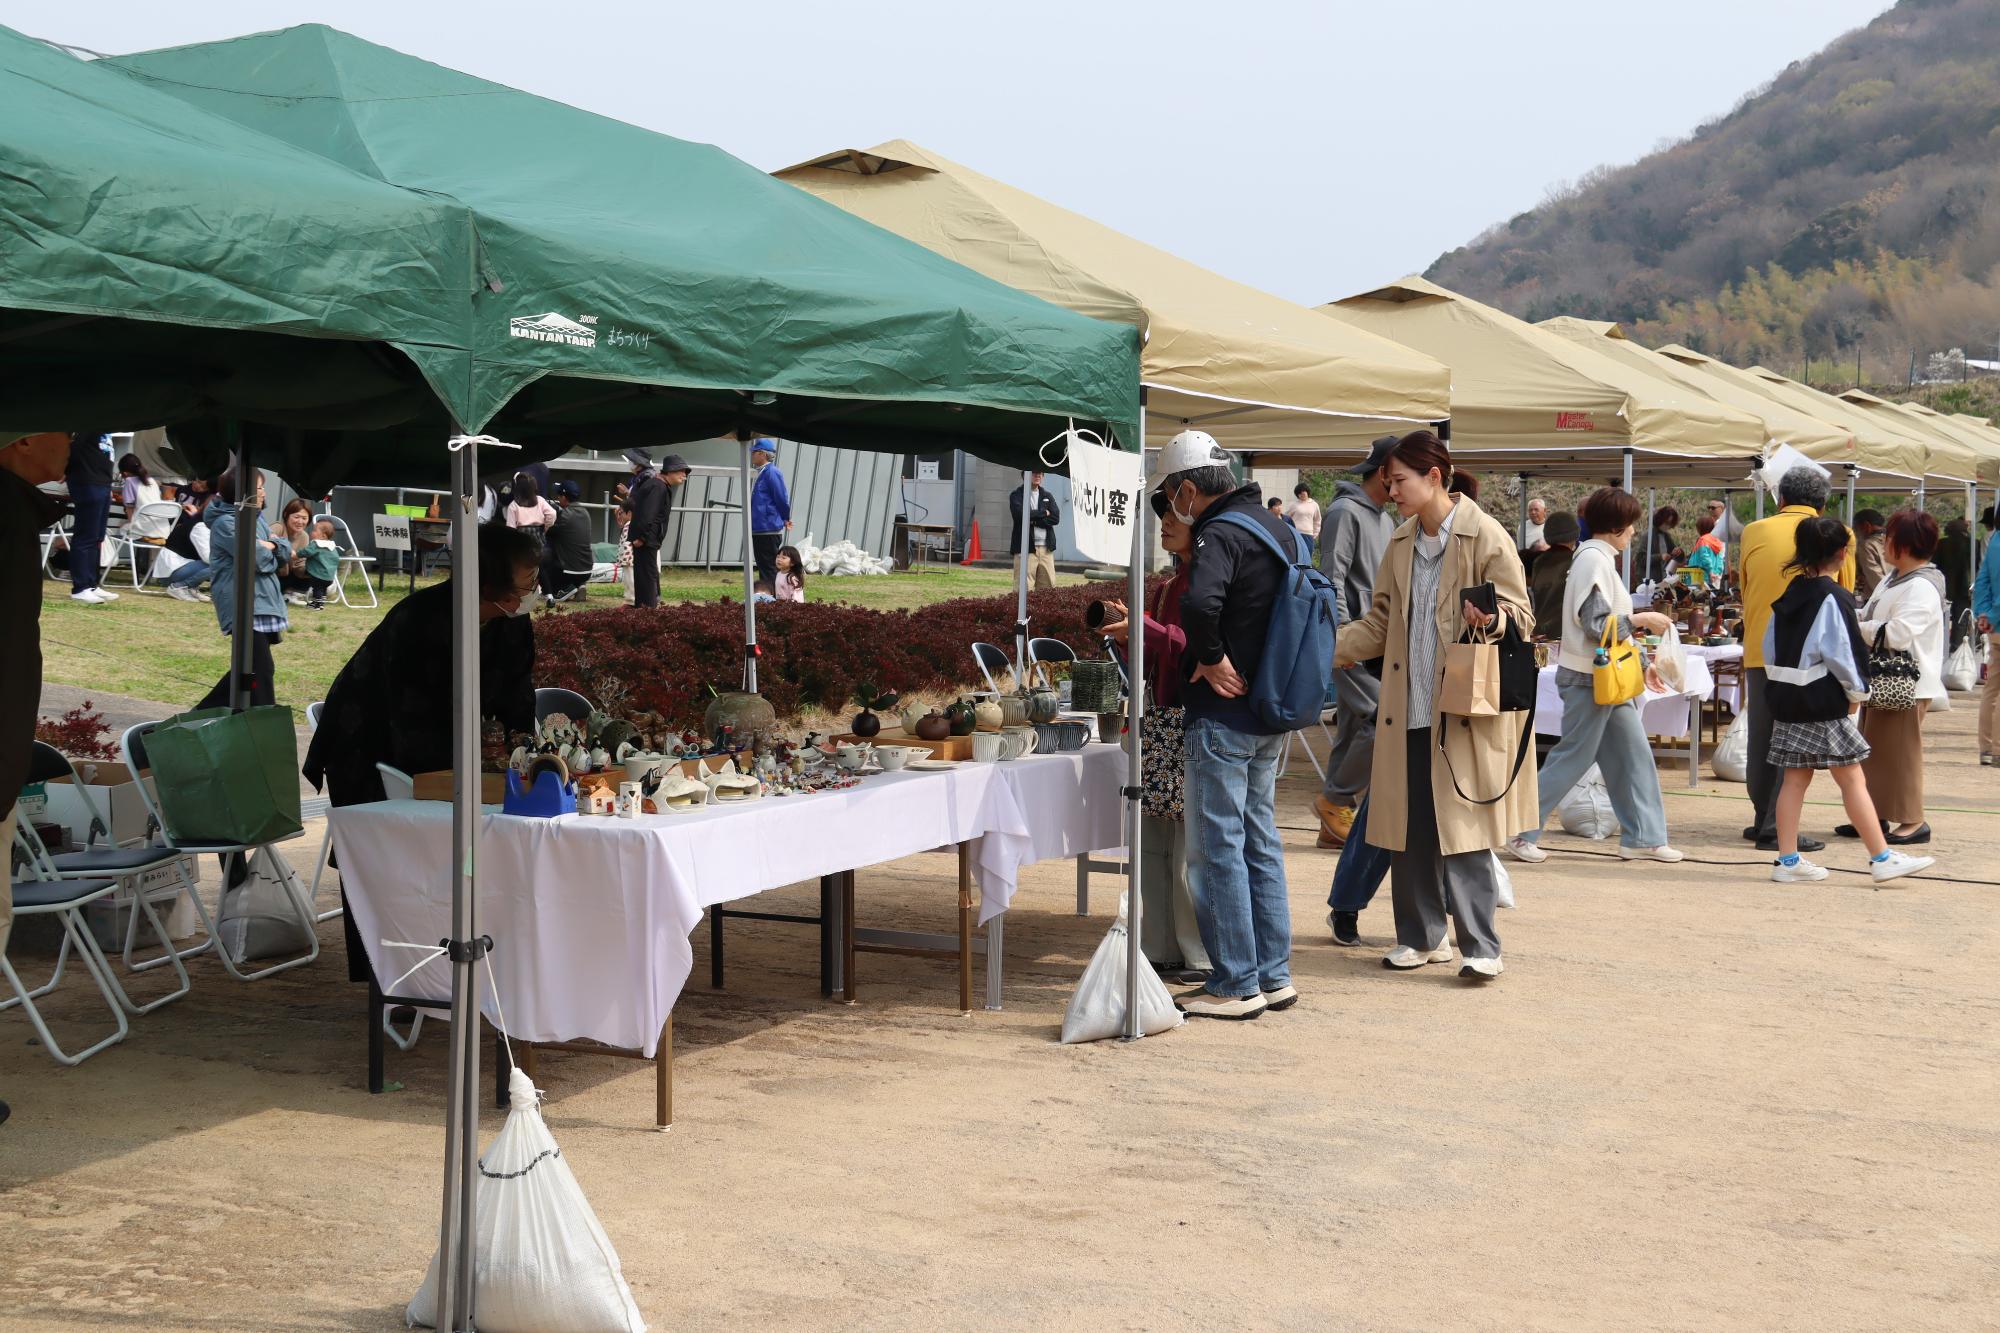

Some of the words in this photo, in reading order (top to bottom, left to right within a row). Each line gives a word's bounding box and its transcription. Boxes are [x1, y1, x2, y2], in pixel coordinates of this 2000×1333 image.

[607, 324, 650, 351] まちづくり
[375, 525, 409, 540] 弓矢体験
